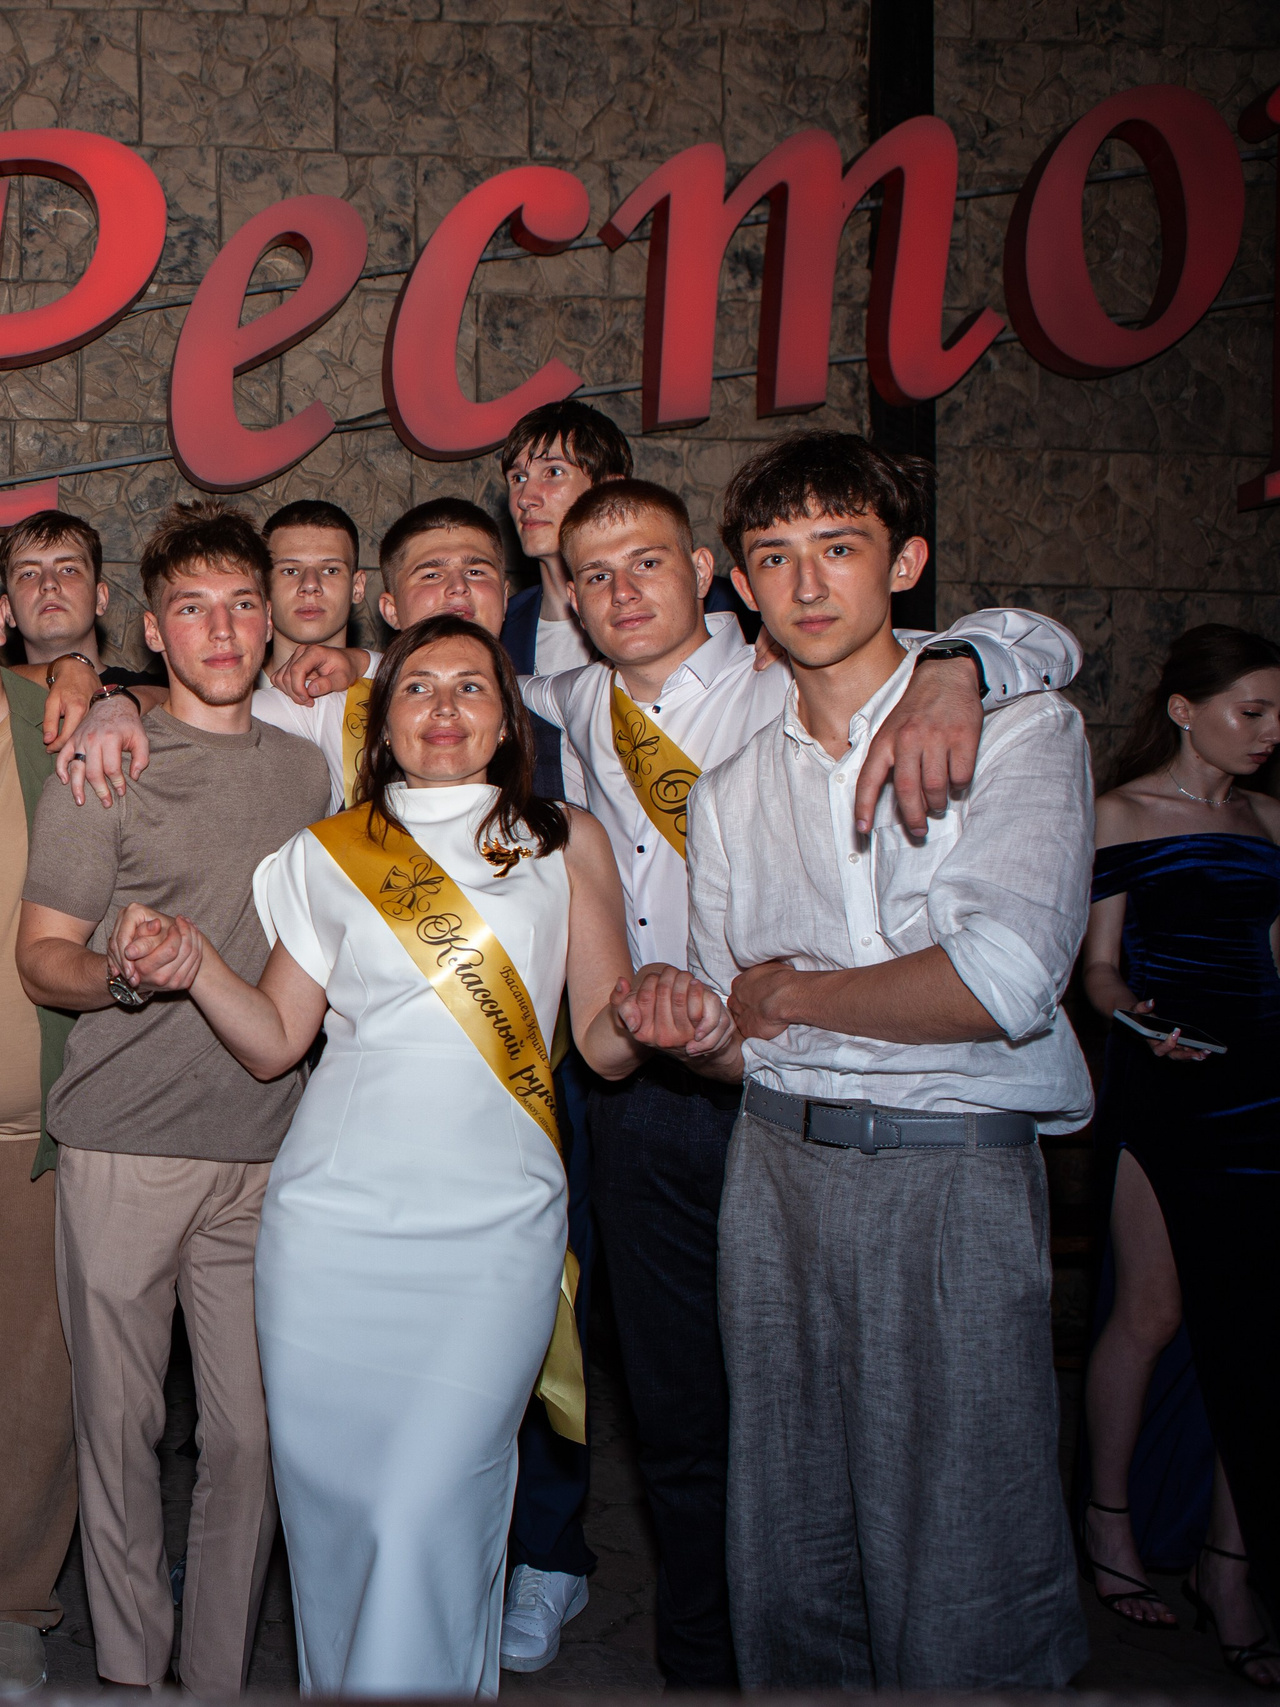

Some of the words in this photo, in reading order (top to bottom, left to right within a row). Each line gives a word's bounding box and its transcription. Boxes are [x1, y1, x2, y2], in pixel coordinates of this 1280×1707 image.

[416, 912, 524, 1061] Классный
[508, 1063, 557, 1117] руко
[499, 965, 532, 1021] Басанец
[526, 1018, 549, 1062] Ирина
